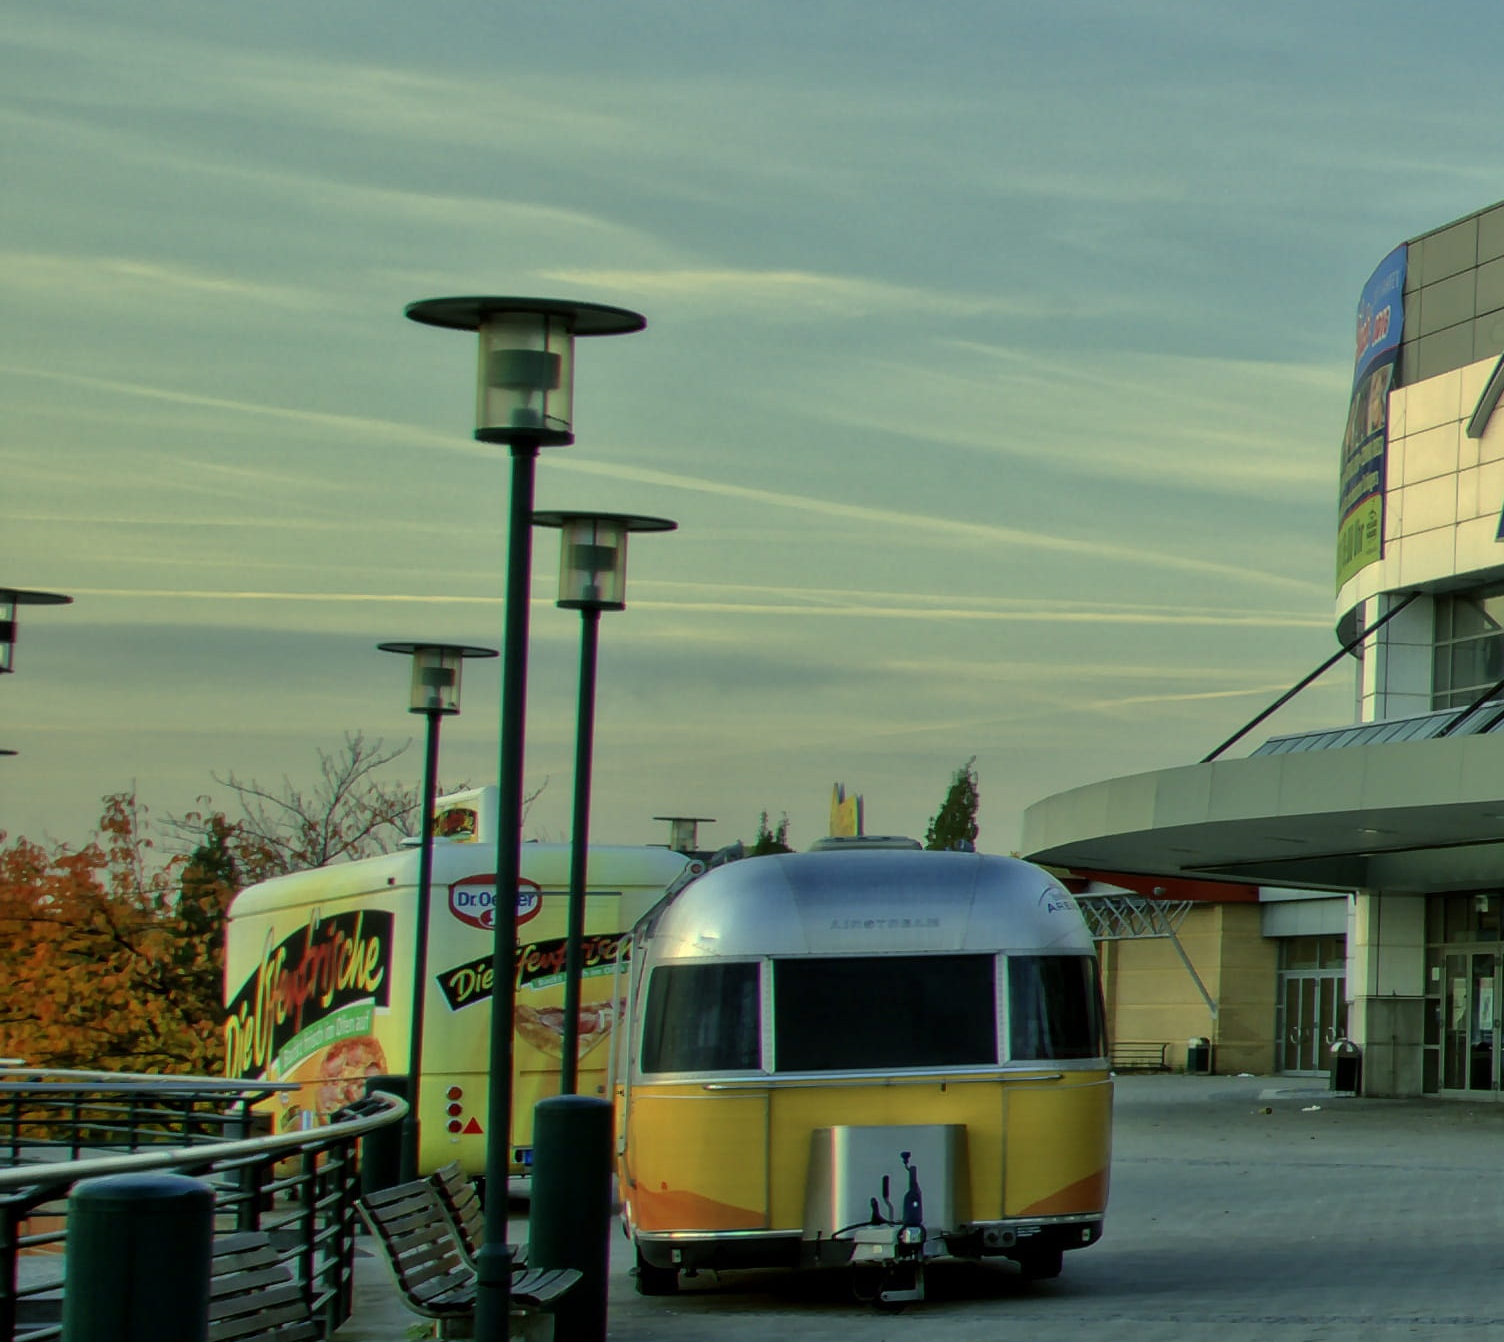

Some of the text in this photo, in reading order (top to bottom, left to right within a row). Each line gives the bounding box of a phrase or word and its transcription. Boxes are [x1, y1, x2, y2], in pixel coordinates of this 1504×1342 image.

[458, 892, 535, 907] Dr. Oeer
[450, 964, 494, 1002] Die
